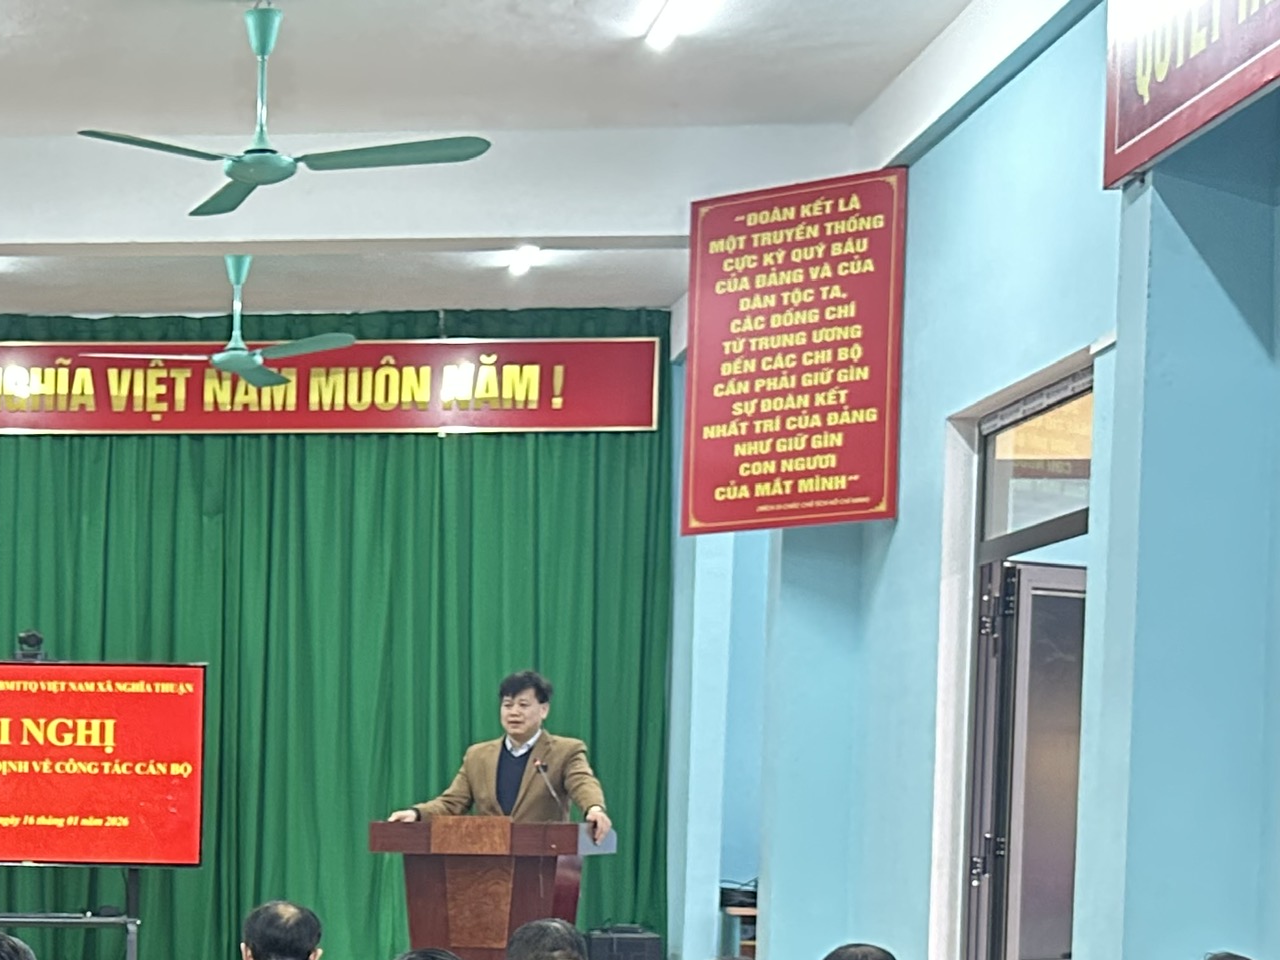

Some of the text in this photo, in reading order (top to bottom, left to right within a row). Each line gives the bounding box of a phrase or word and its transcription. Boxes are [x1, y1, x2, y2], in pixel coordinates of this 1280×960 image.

[800, 196, 834, 218] KẾT
[838, 193, 861, 212] LÀ
[708, 234, 747, 254] MỘT
[722, 255, 758, 274] CỰC
[830, 237, 869, 256] BÁU
[715, 256, 875, 294] CỦA ĐẢNG VÀ CỦA
[780, 287, 814, 308] TỘC
[750, 331, 807, 352] TRUNG
[812, 324, 863, 344] ƯƠNG
[761, 352, 797, 371] CÁC
[801, 349, 833, 366] CHI
[837, 343, 863, 363] BỘ
[107, 359, 192, 421] VIỆT
[203, 367, 297, 412] NAM
[309, 355, 431, 411] MUÔN
[440, 354, 541, 410] NĂM
[754, 370, 796, 393] PHẢI
[731, 385, 848, 417] SỰ ĐOÀN KẾT
[753, 418, 781, 434] TRÍ
[785, 410, 822, 430] CỦA
[826, 405, 878, 426] ĐẢNG
[734, 438, 774, 457] NHƯ
[739, 460, 776, 477] CON
[714, 480, 750, 501] CỦA
[40, 680, 66, 694] VIỆT
[69, 681, 95, 693] NAM
[97, 679, 114, 693] XÃ
[20, 717, 116, 754] NGHỊ
[32, 758, 53, 774] VỀ
[54, 758, 99, 774] CÔNG
[101, 759, 133, 775] TÁC
[134, 759, 168, 775] CÁN
[170, 761, 193, 778] BỘ
